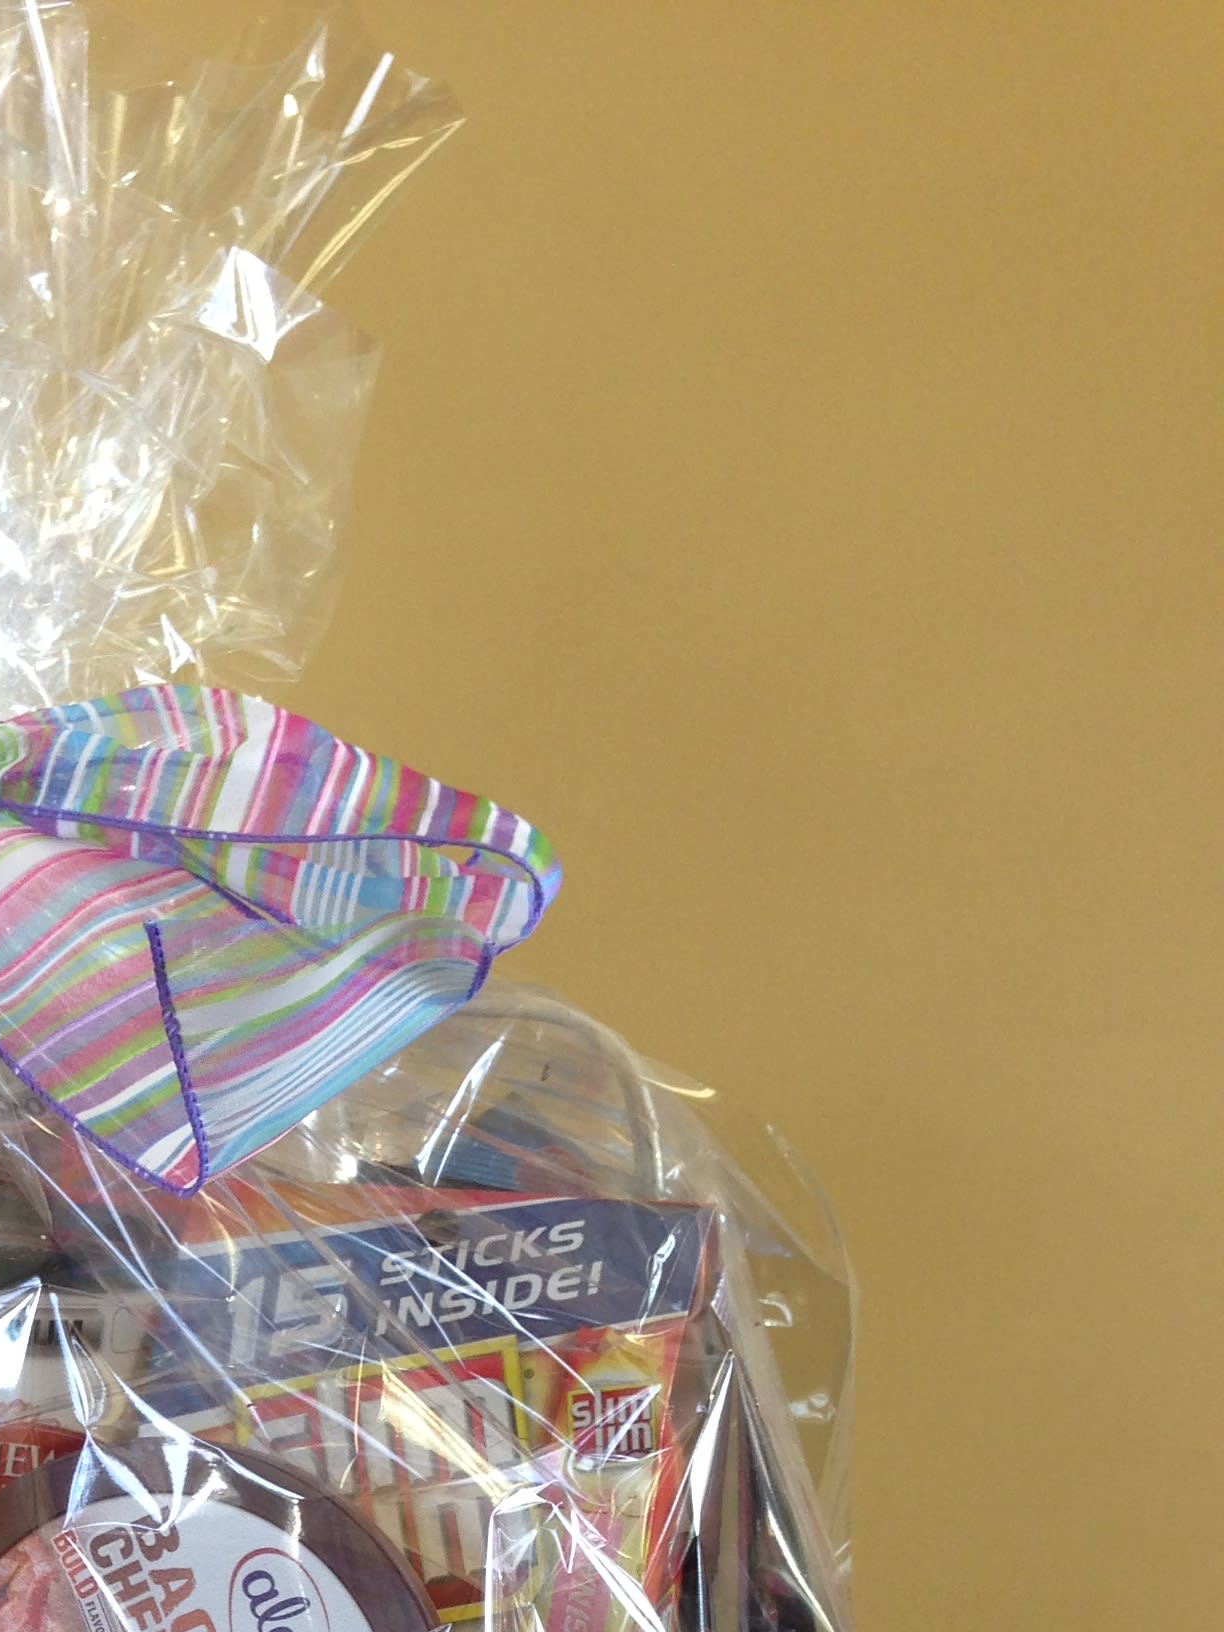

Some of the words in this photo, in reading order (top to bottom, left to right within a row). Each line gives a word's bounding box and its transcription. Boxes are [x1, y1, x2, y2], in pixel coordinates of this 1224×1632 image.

[379, 1220, 585, 1287] STICKS
[375, 1261, 604, 1337] INSIDE!
[53, 1530, 98, 1600] BOLD
